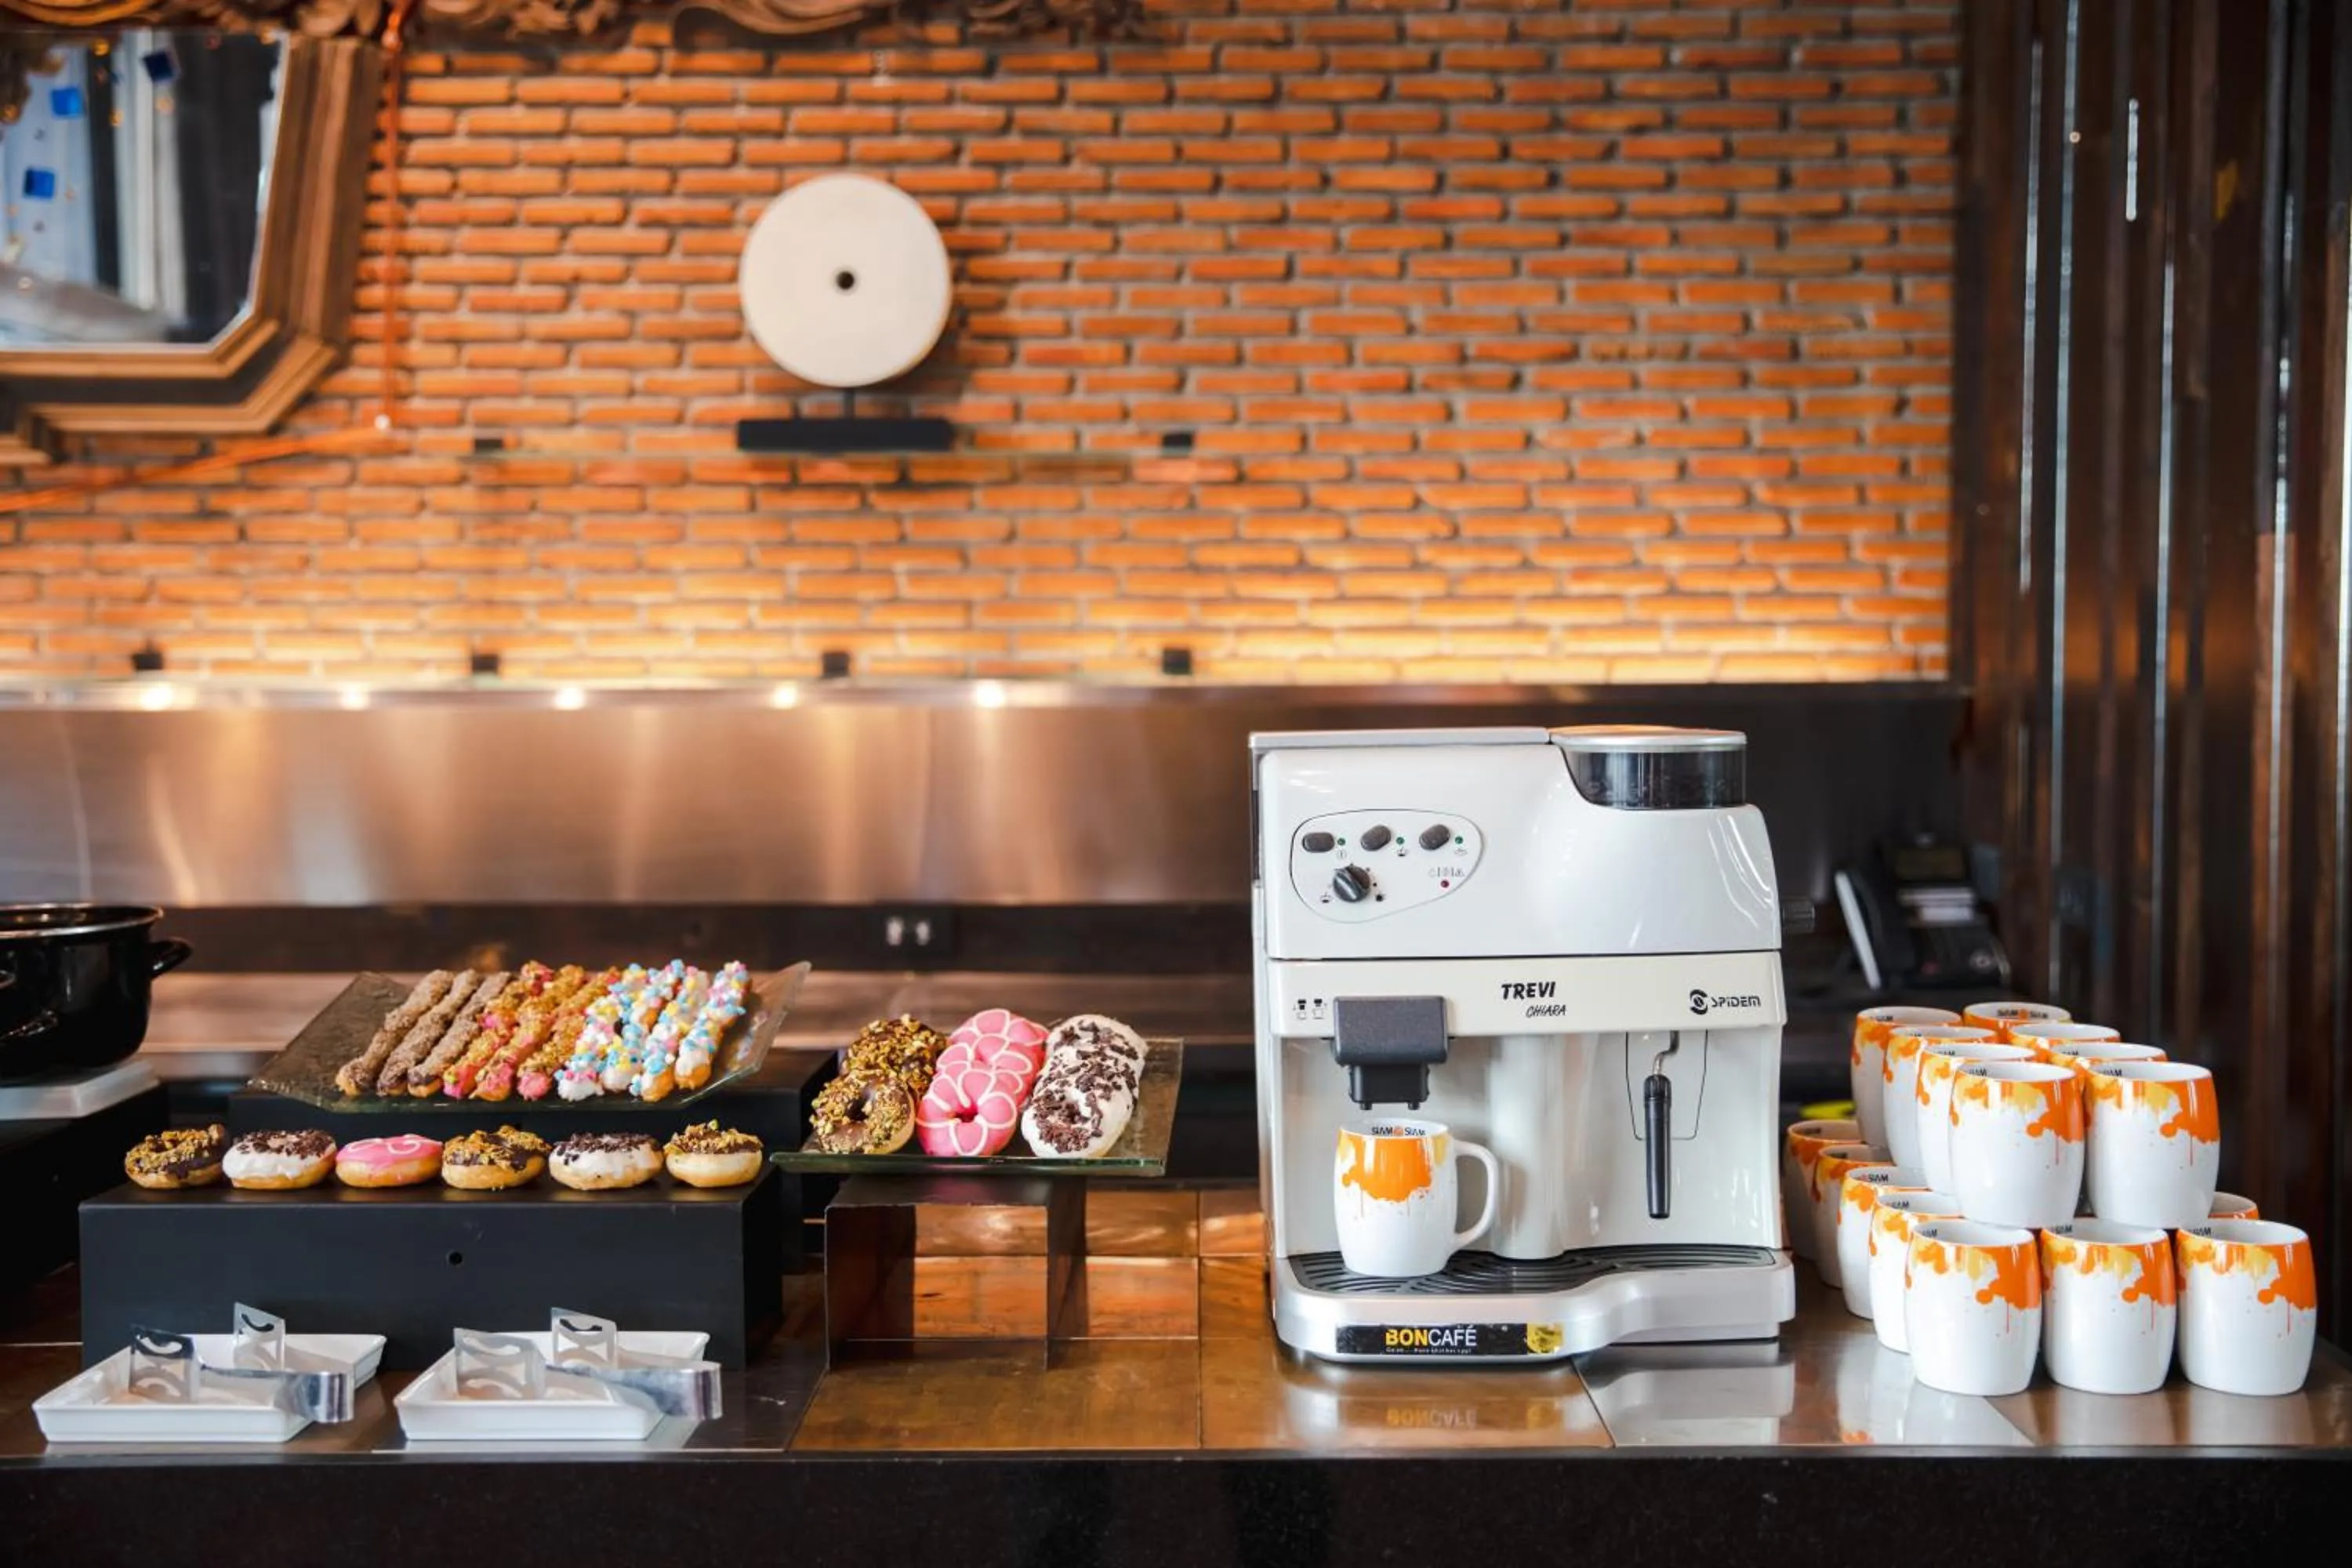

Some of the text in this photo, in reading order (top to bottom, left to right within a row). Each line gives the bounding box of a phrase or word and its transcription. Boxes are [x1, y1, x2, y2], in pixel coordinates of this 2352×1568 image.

[1501, 982, 1556, 1000] TREVI
[1526, 1004, 1566, 1018] CHIARA
[1385, 1326, 1478, 1347] BONCAFÉ
